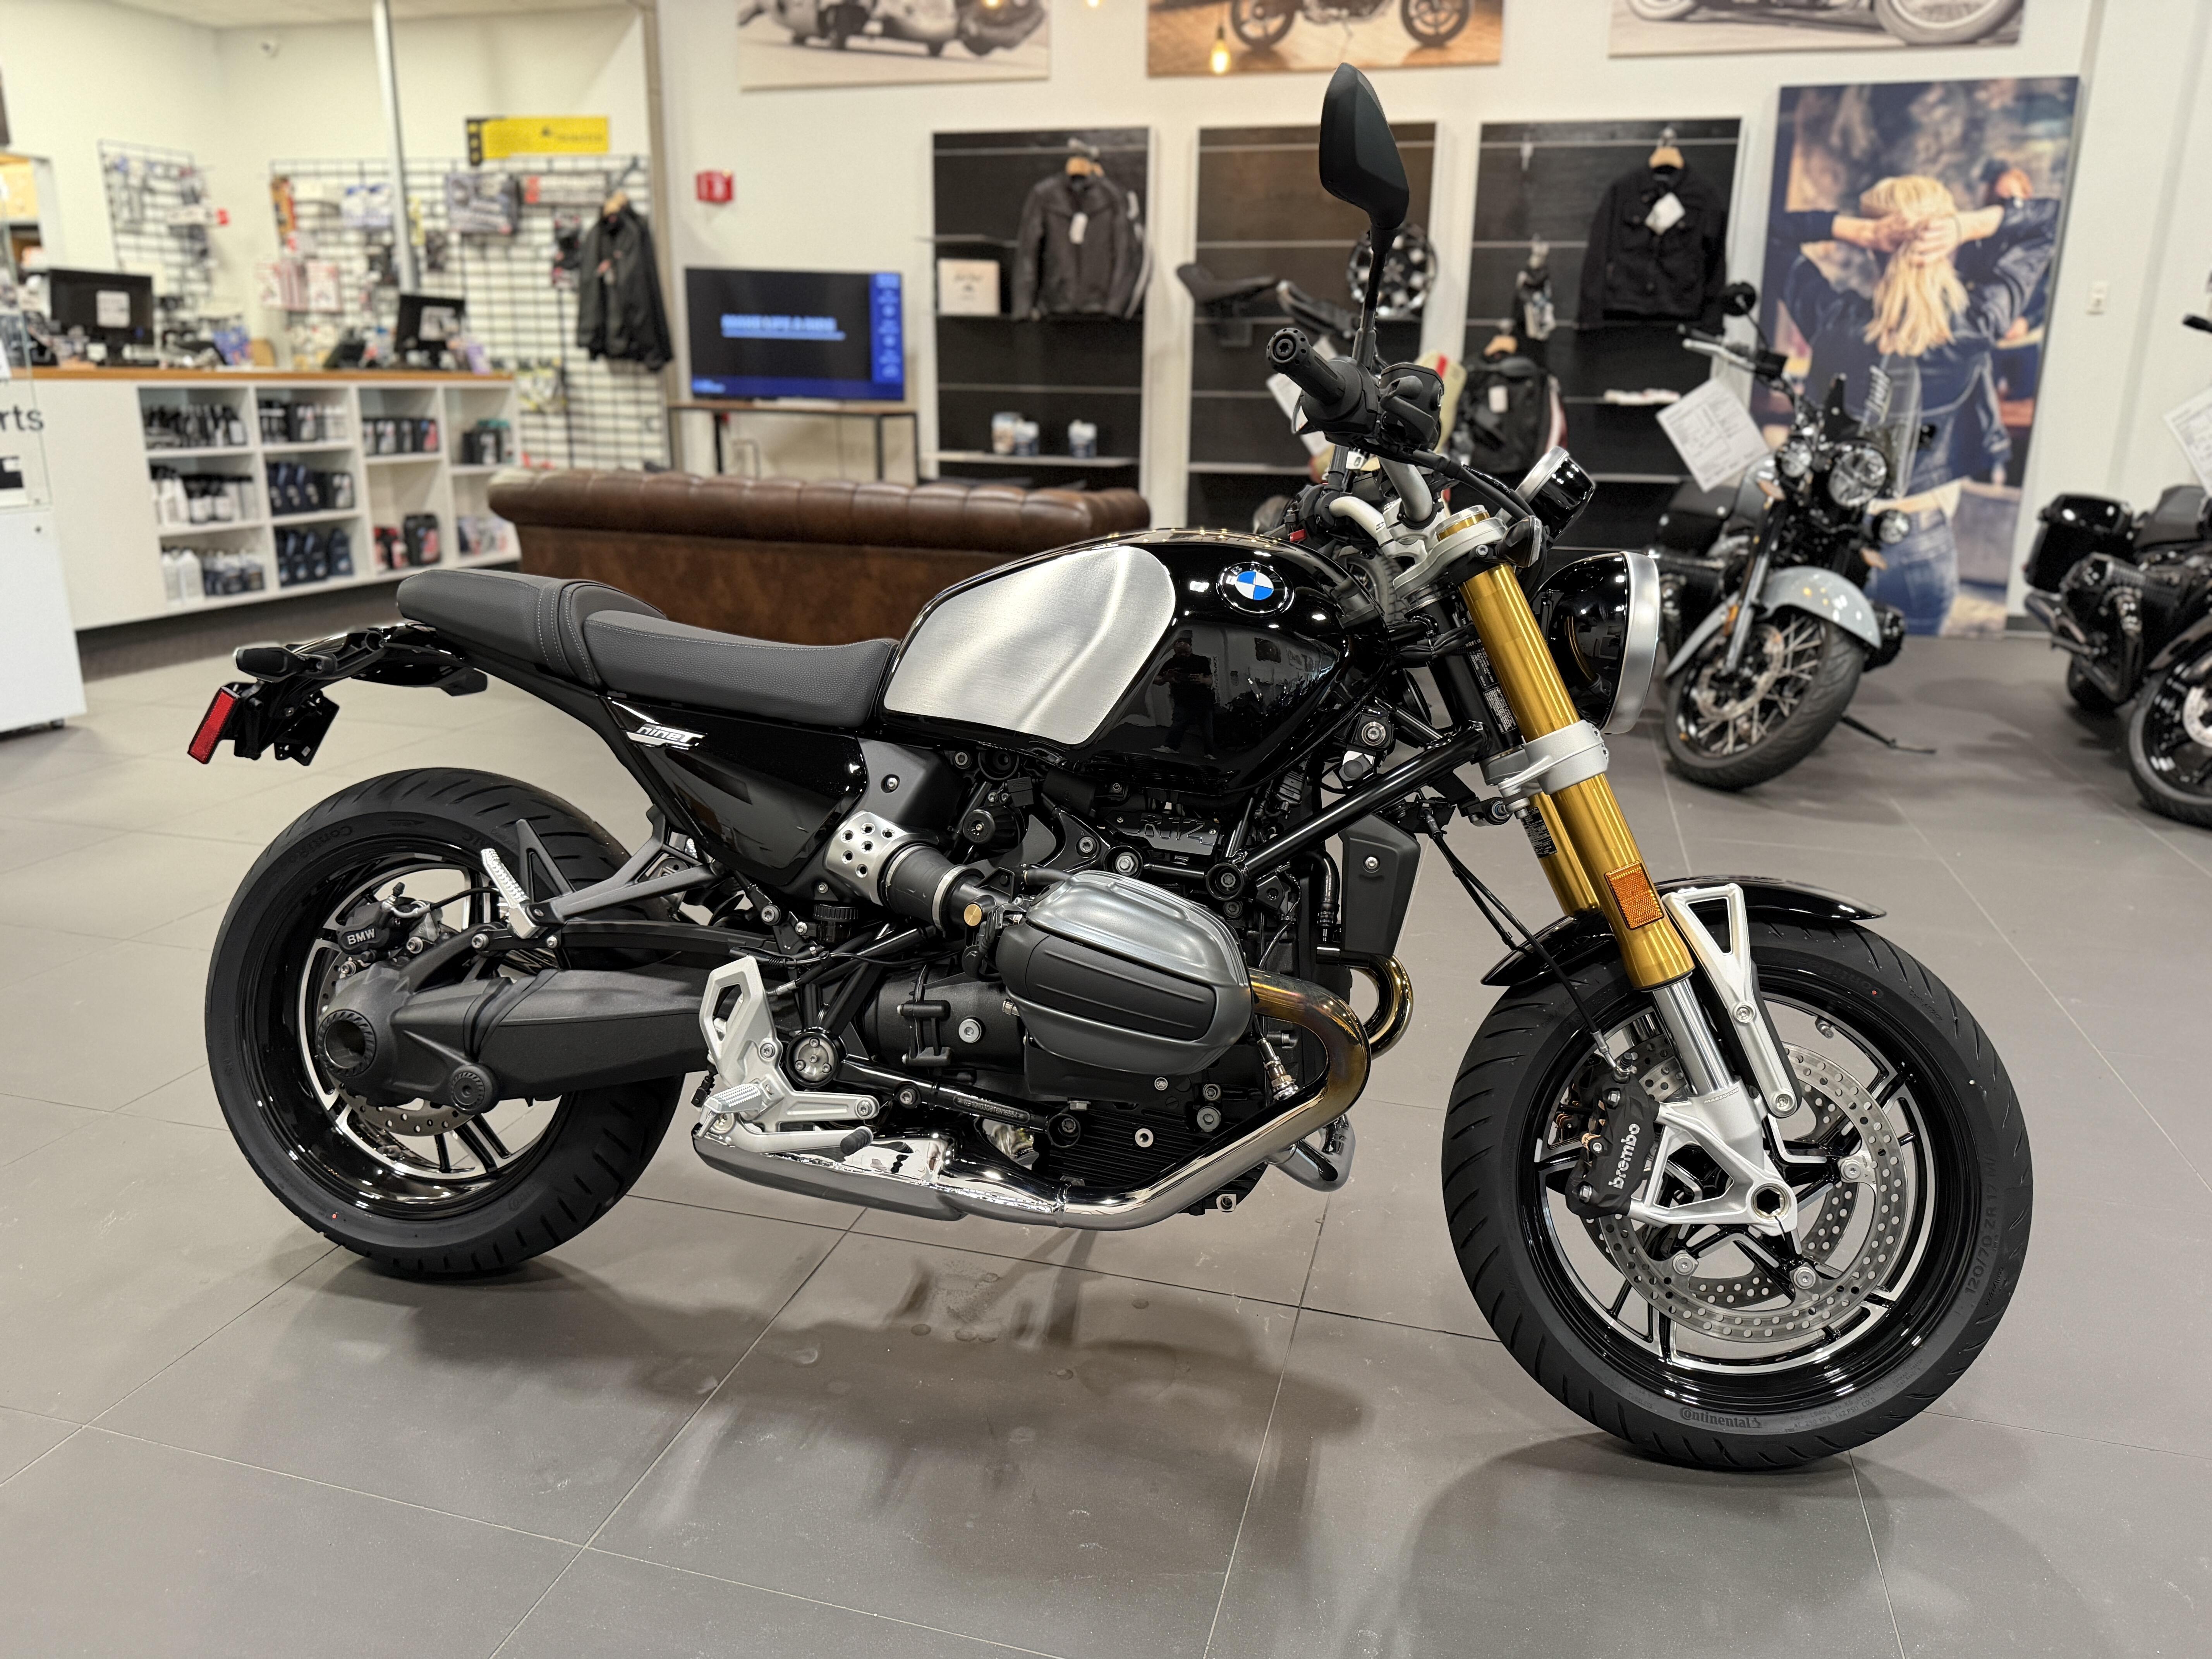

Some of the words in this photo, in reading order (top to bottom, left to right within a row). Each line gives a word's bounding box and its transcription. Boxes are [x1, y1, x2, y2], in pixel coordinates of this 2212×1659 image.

[1231, 563, 1281, 582] BMW
[347, 928, 375, 945] BMW
[1704, 1087, 1739, 1104] MARZOCCHI
[1608, 1123, 1640, 1189] brembo
[1986, 1183, 1997, 1199] 17
[1984, 1206, 1996, 1229] ZR
[1965, 1235, 1993, 1294] 120/70
[1680, 1407, 1751, 1428] Continental
